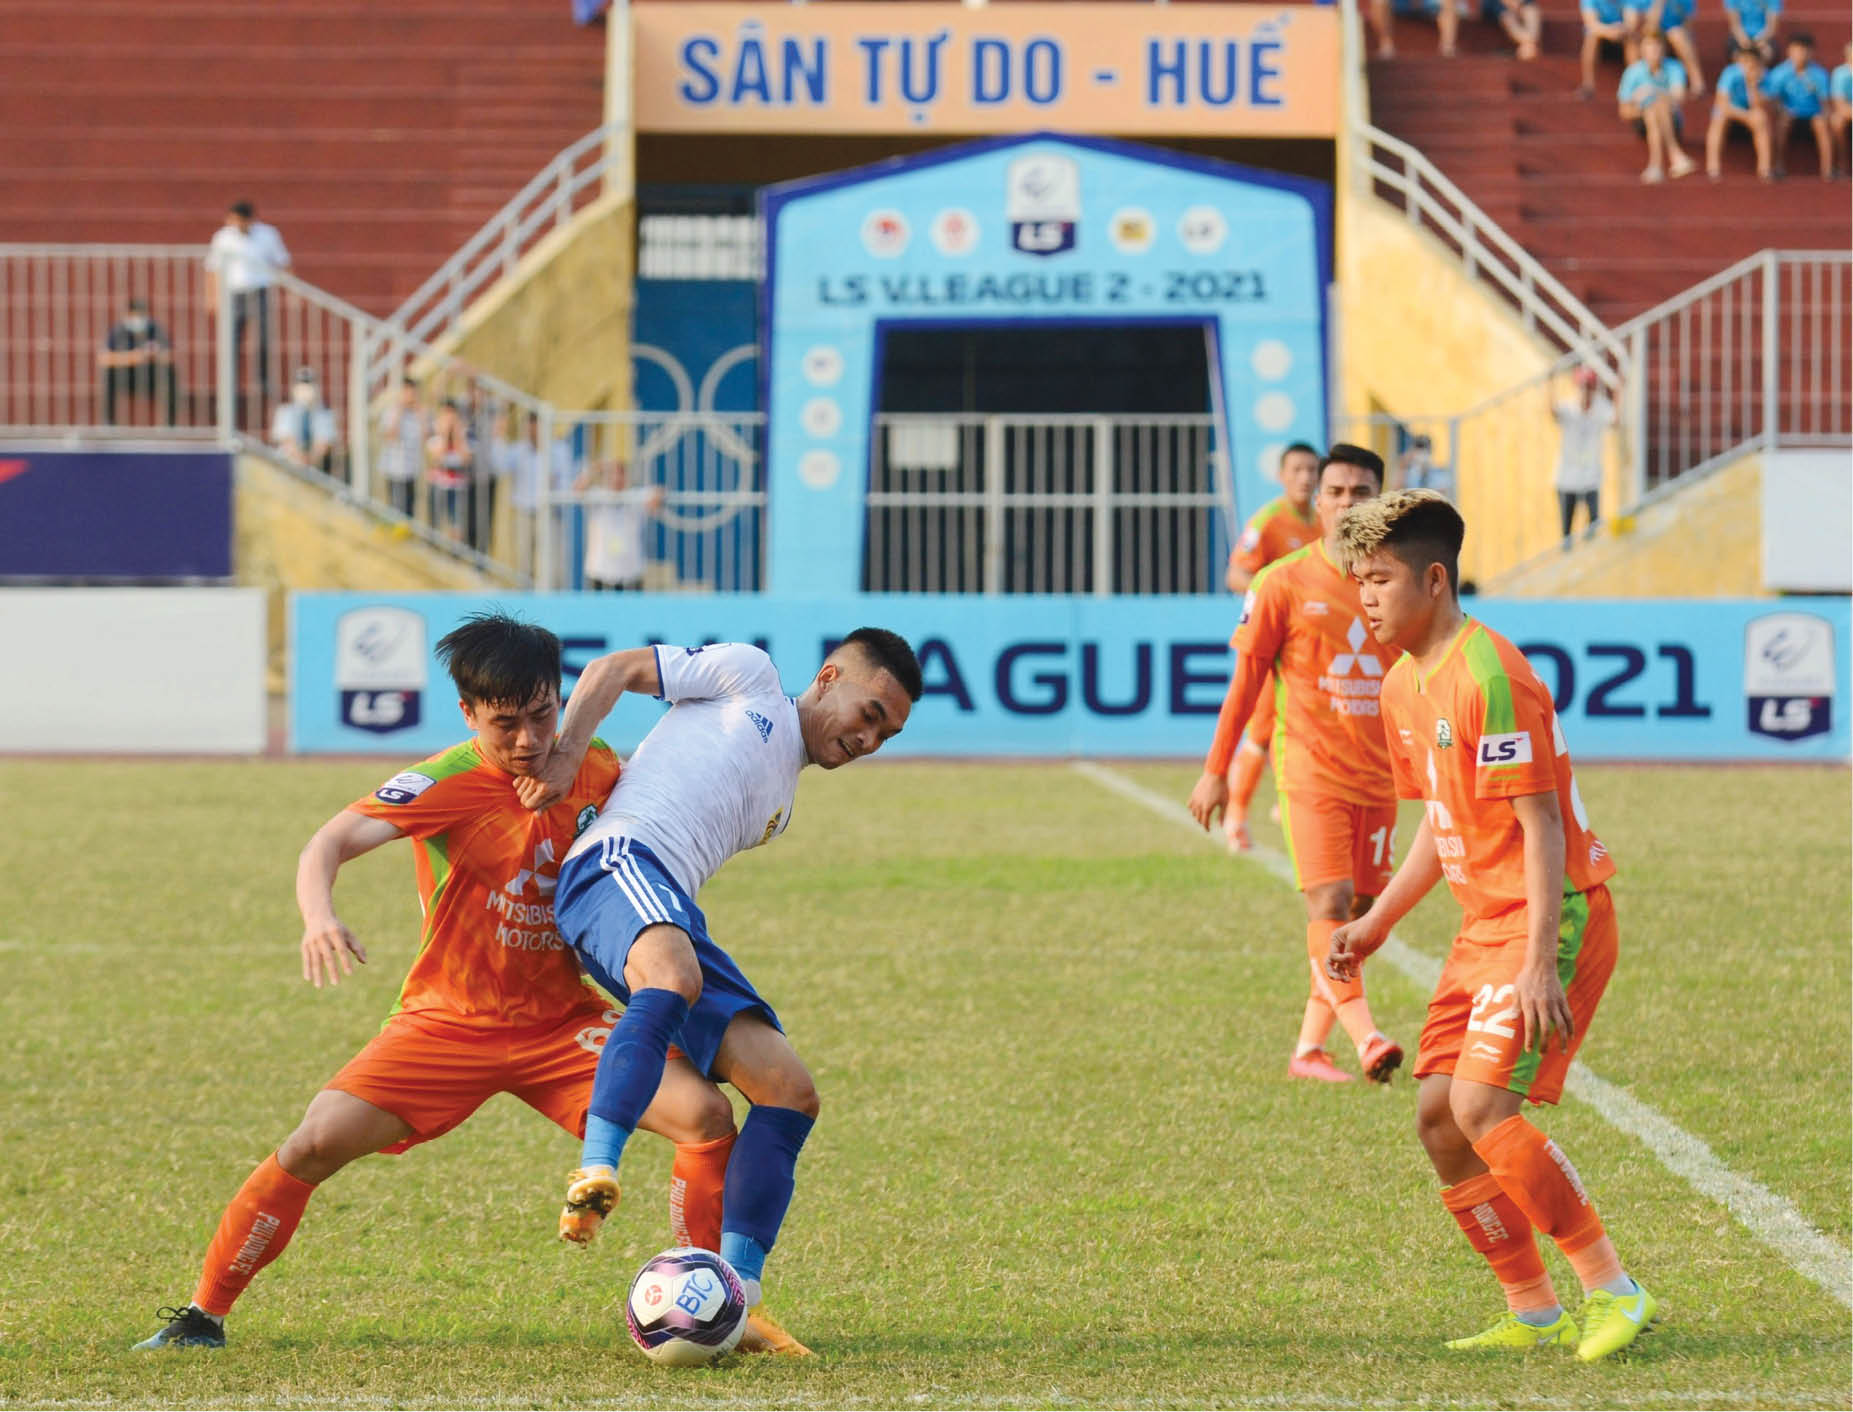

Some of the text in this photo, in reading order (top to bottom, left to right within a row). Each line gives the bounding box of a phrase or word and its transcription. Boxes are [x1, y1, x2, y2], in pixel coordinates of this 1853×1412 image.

[858, 33, 948, 121] TỰ
[973, 40, 1061, 104] DO
[1149, 14, 1290, 105] HUẾ
[1016, 221, 1064, 250] LS
[818, 274, 868, 305] LS
[880, 271, 1092, 305] V.LEAGUE
[1107, 270, 1129, 301] 2
[1165, 269, 1267, 300] 2021
[1517, 642, 1713, 718] 021
[350, 692, 405, 726] LS
[744, 709, 769, 744] adidas
[1759, 698, 1813, 732] LS
[1481, 741, 1516, 762] LS
[379, 789, 405, 800] LS
[1467, 983, 1521, 1039] 22
[674, 1273, 714, 1316] BTC
